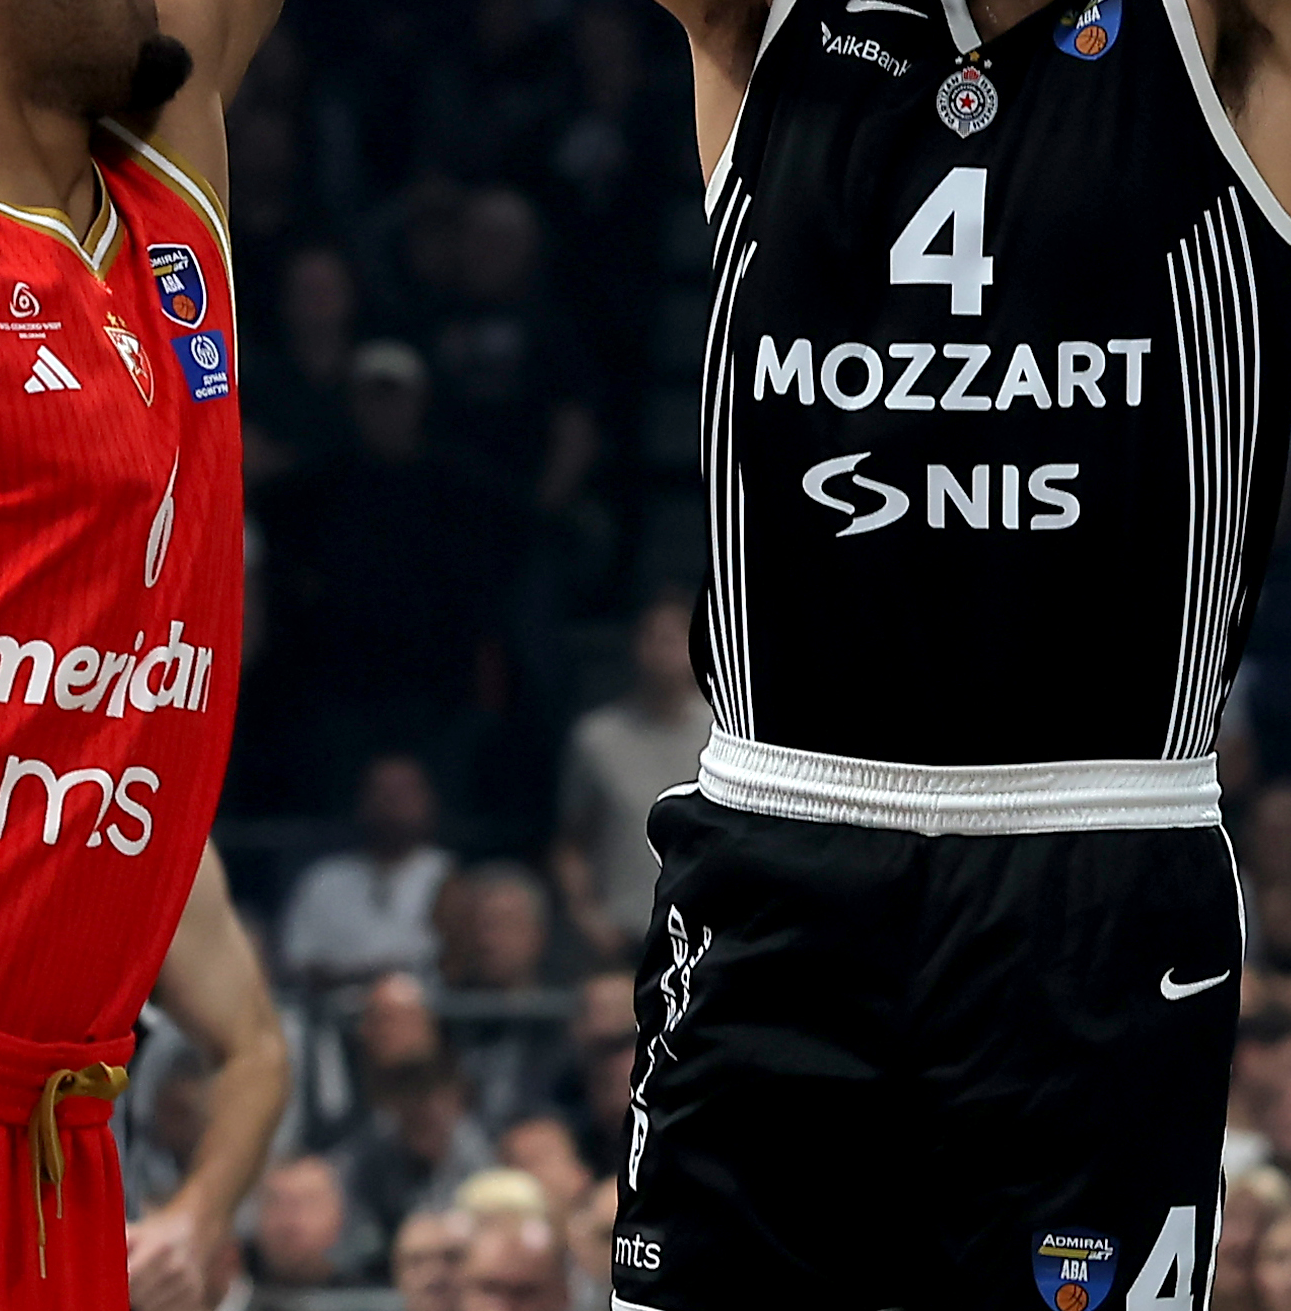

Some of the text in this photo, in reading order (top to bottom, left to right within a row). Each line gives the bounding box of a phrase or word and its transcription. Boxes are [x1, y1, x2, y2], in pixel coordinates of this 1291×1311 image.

[890, 167, 993, 316] 4
[161, 273, 185, 294] ABA
[753, 335, 1152, 411] MOZZART
[927, 463, 1081, 530] NIS
[615, 1233, 661, 1270] mts
[1042, 1233, 1113, 1252] ADMIRAL
[1126, 1205, 1197, 1311] 4
[1060, 1258, 1088, 1282] ABA
